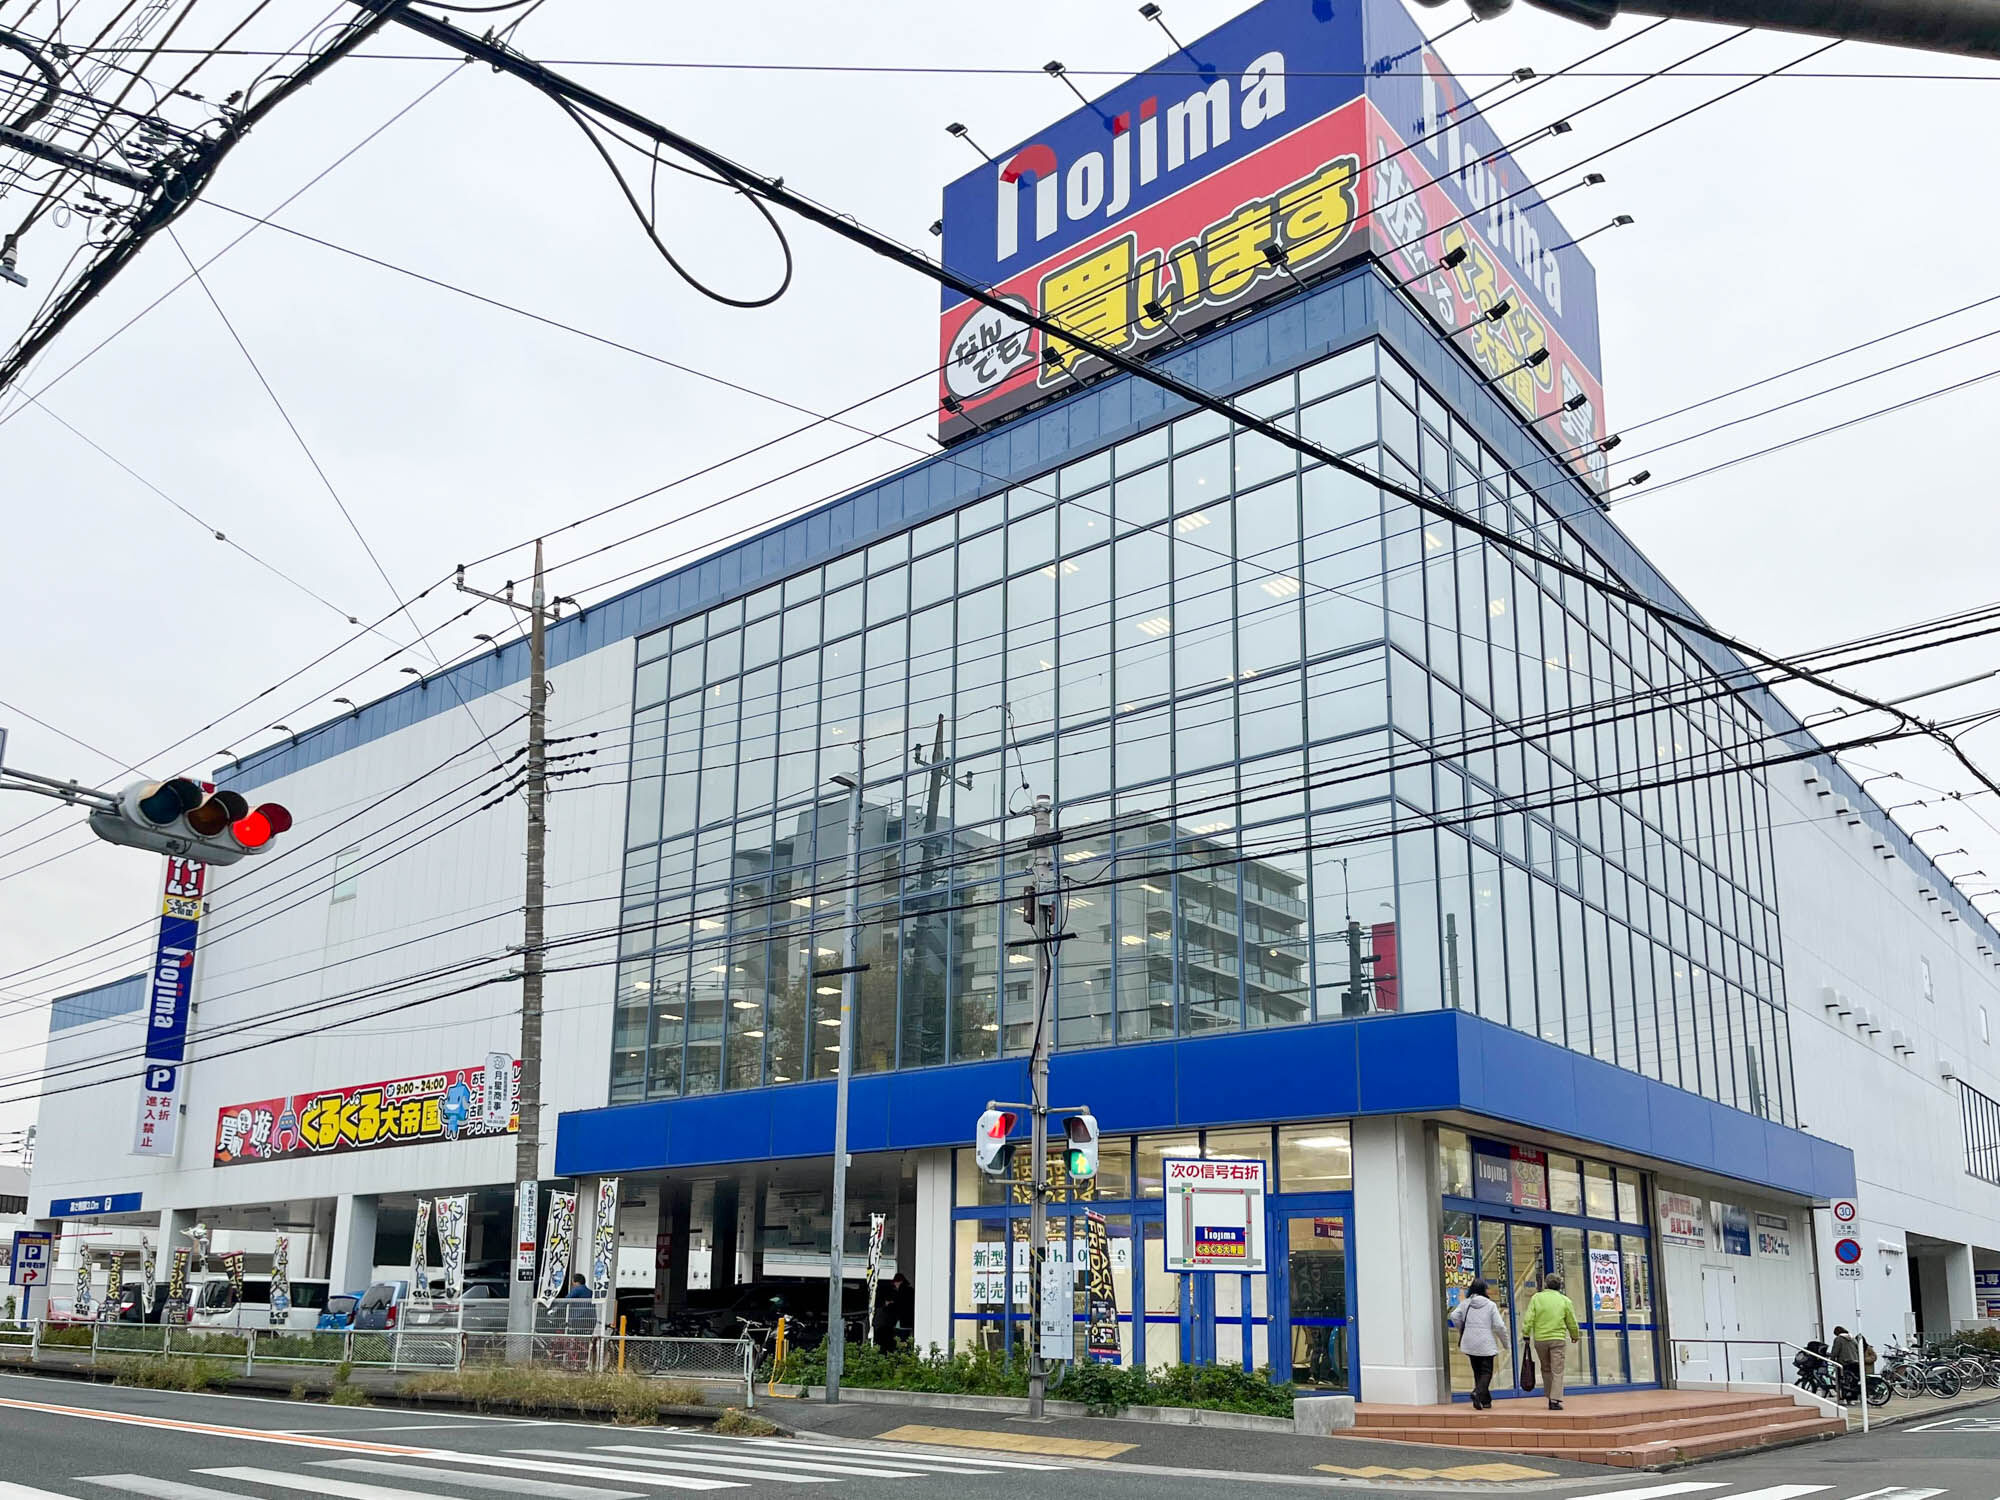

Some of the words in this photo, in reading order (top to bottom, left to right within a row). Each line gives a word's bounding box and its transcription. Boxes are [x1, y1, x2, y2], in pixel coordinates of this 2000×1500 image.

[997, 50, 1287, 262] nojima
[1039, 160, 1354, 382] 買います
[154, 946, 194, 1028] nojima
[141, 1096, 158, 1148] 進入禁止
[158, 1097, 172, 1121] 右折
[1171, 1164, 1259, 1180] 次の信号右折
[1204, 1227, 1236, 1240] nojima
[1839, 1207, 1851, 1217] 30
[108, 1256, 121, 1299] FRIDAY
[1087, 1219, 1104, 1300] FRIDAY
[1097, 1222, 1113, 1300] BLACK
[973, 1281, 1028, 1300] 発売中
